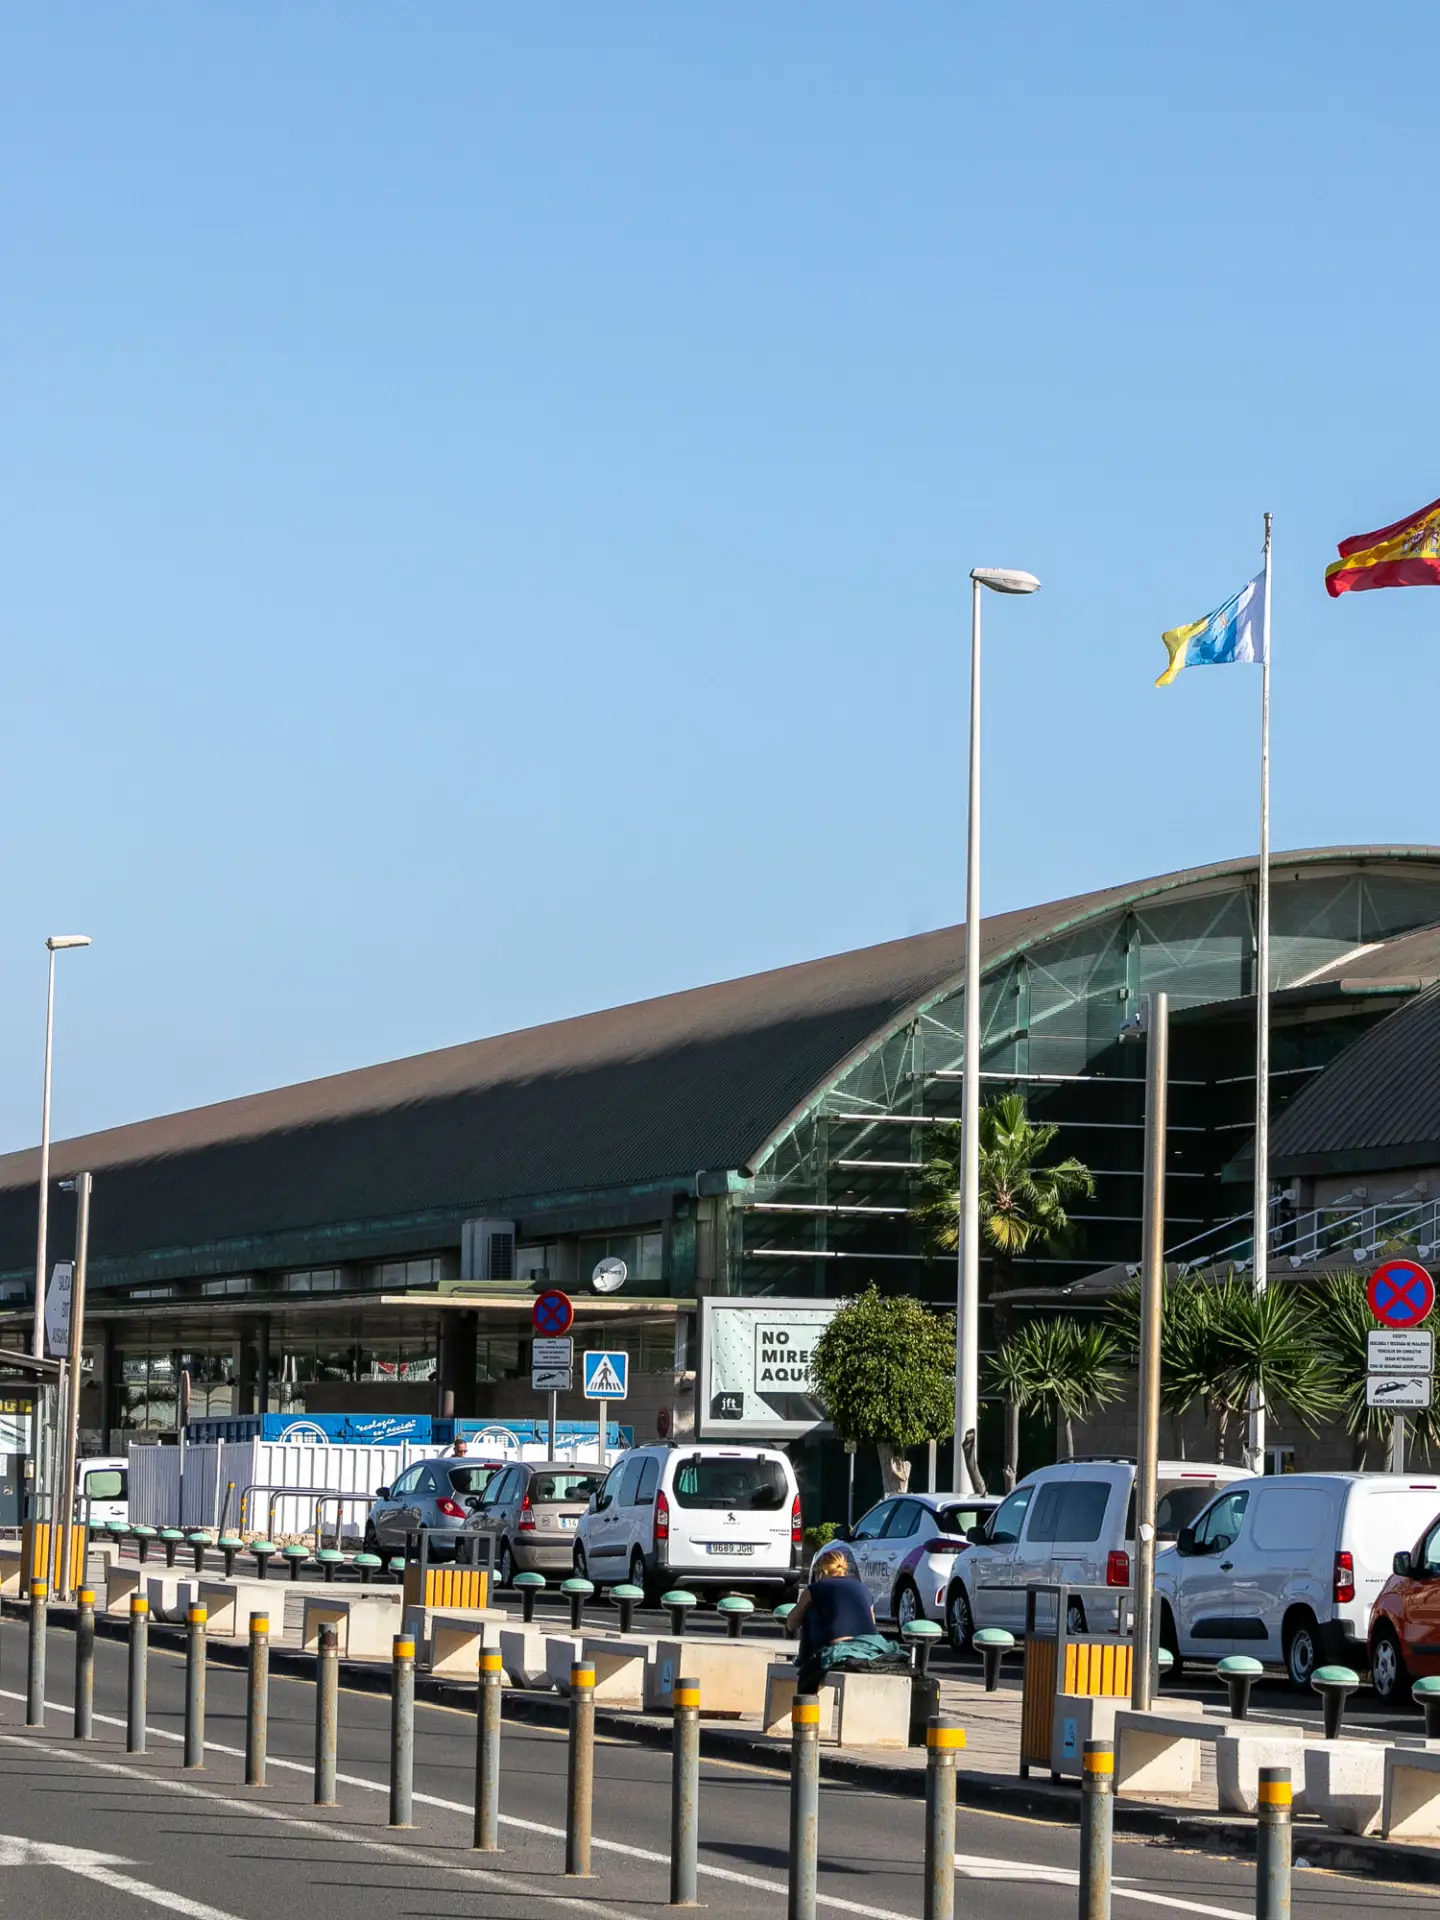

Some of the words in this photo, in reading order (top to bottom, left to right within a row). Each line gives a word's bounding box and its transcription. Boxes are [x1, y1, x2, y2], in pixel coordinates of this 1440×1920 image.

[761, 1331, 790, 1345] NO
[721, 1397, 737, 1411] jft
[712, 1543, 734, 1552] 9689
[737, 1543, 752, 1553] JGH
